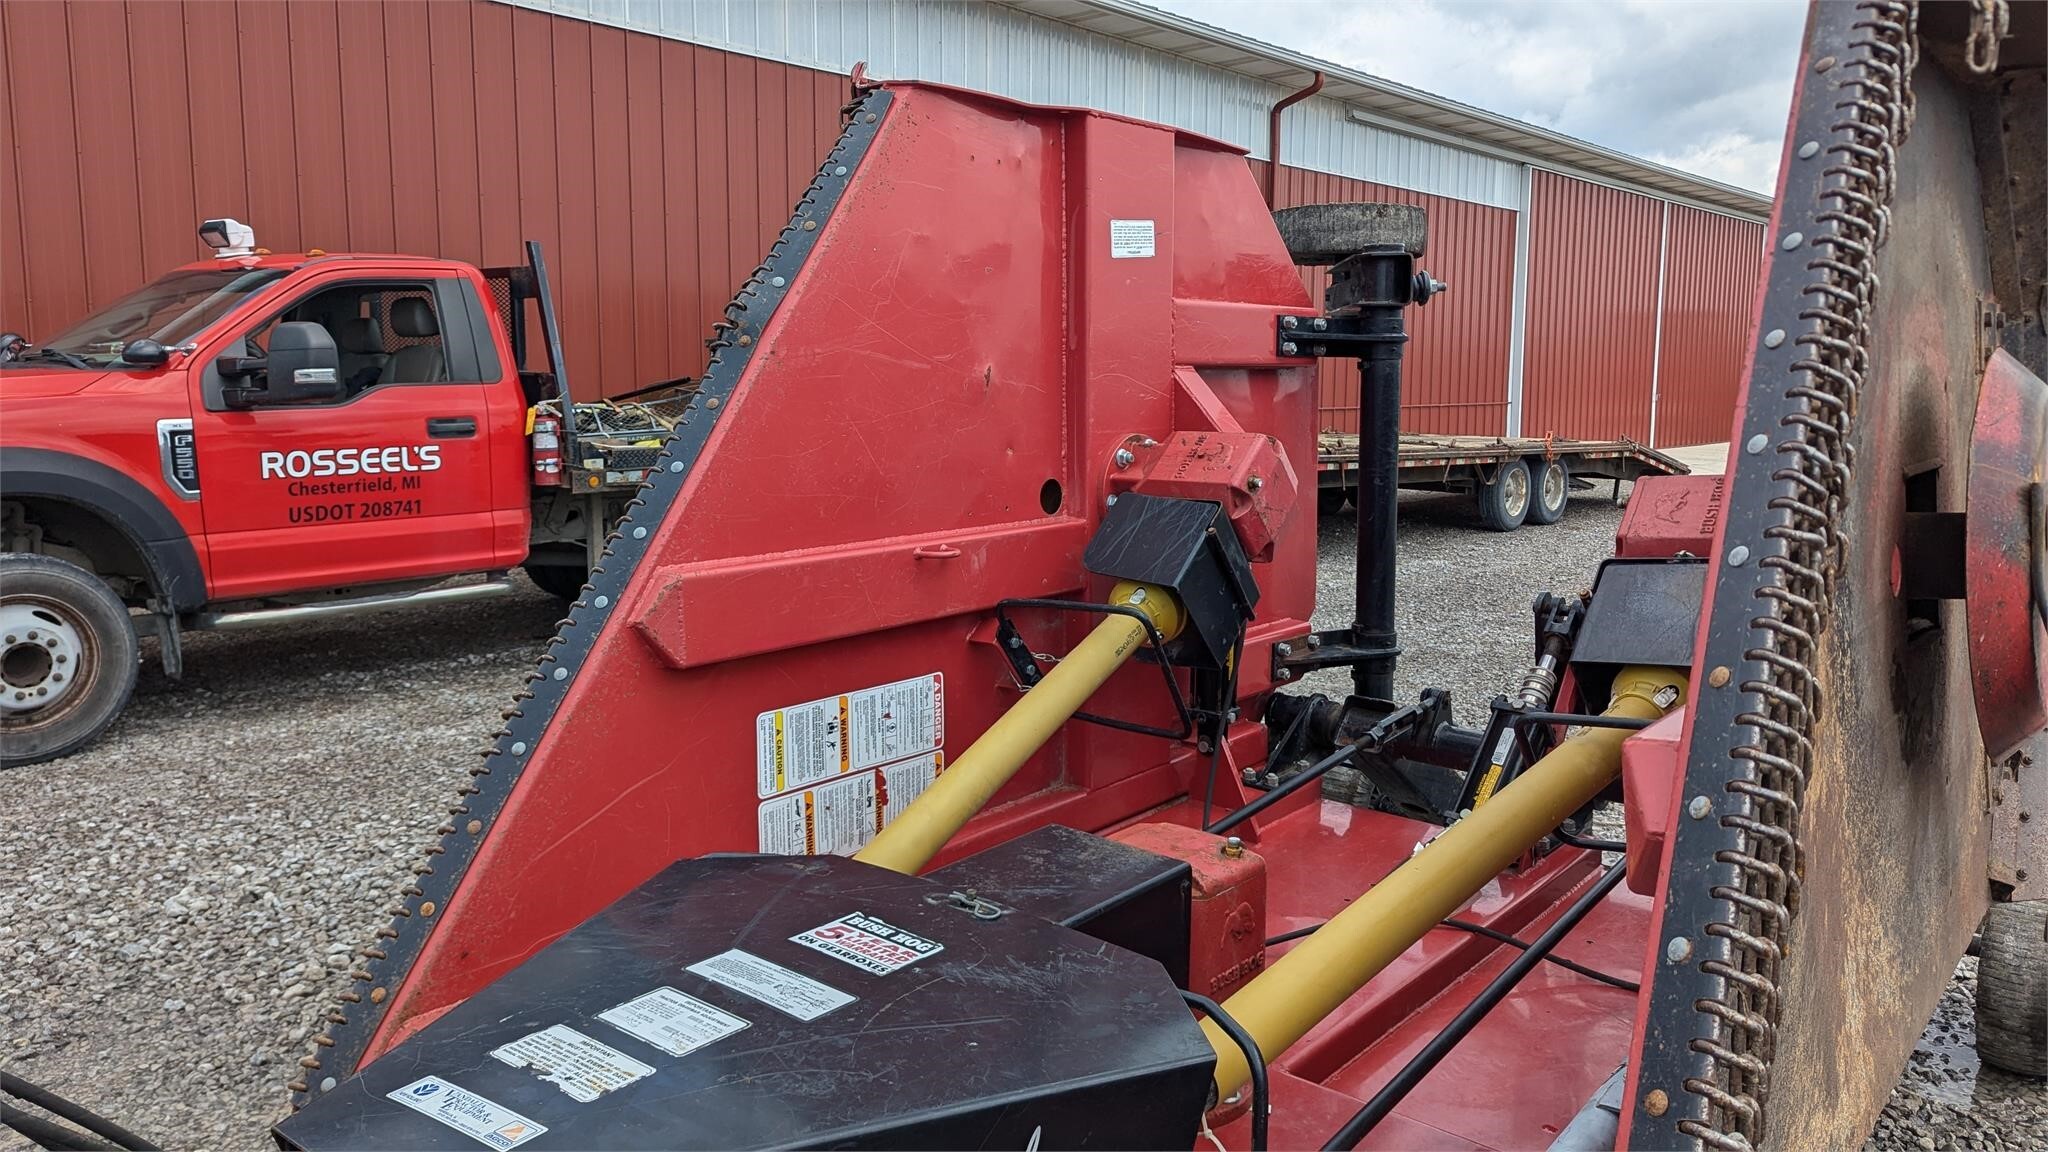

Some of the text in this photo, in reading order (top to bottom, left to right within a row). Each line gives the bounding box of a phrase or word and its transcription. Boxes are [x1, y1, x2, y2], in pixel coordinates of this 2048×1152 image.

[175, 435, 195, 479] F550
[261, 445, 441, 480] ROSSEEL'S
[288, 476, 421, 496] Chesterfield, MI
[289, 500, 422, 523] USDOT 208741
[934, 692, 942, 740] DANGER
[840, 718, 848, 762] WARNING
[814, 925, 919, 958] 5 YEAR
[846, 916, 934, 952] BUSH HOG
[846, 936, 910, 962] LIMITED
[799, 935, 889, 973] ON GEARBOXES
[836, 939, 902, 966] WARRANTY
[580, 1040, 616, 1059] IMPORTANT
[486, 1133, 512, 1147] AGCO
